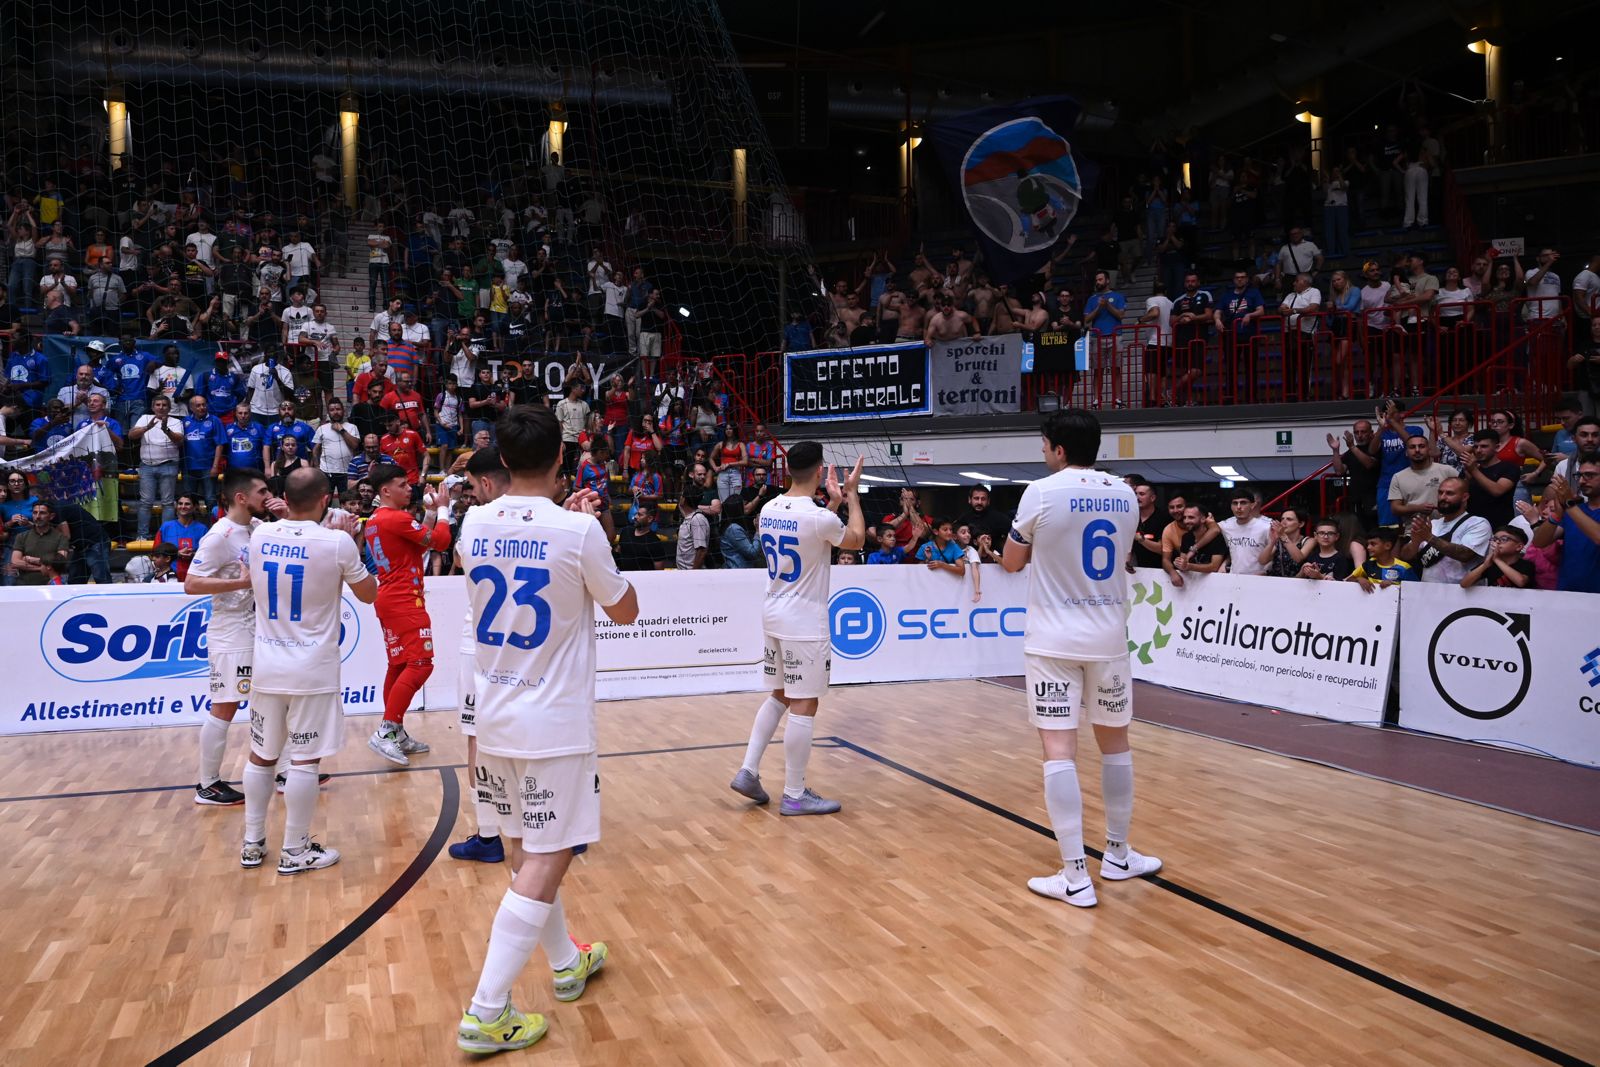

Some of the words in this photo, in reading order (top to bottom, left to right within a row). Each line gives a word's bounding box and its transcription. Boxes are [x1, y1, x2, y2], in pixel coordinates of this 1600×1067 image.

[1041, 335, 1068, 346] ULTRAS
[946, 343, 1005, 360] sporchi
[817, 354, 899, 381] EFFETTO
[954, 360, 998, 373] brutti
[971, 371, 983, 385] &
[794, 384, 921, 411] COLLATERALE
[937, 385, 1017, 406] terroni
[1070, 498, 1130, 513] PERUGINO
[760, 517, 798, 533] SAPONARA
[261, 542, 310, 560] CANAL
[472, 538, 489, 557] DE
[494, 539, 549, 561] SIMONE
[761, 533, 802, 583] 65
[1082, 518, 1117, 581] 6
[262, 561, 305, 622] 11
[469, 564, 552, 650] 23
[638, 616, 670, 628] quadri
[672, 614, 711, 625] elettrici
[712, 616, 728, 626] per
[57, 611, 210, 664] Sorb
[595, 630, 630, 640] estione
[641, 629, 647, 638] il
[650, 627, 697, 638] controllo.
[1181, 603, 1382, 667] siciliarottami
[1176, 647, 1194, 660] Rifiuti
[1195, 650, 1220, 666] speciali
[1220, 655, 1258, 673] pericolosi,
[1260, 664, 1275, 674] non
[1276, 666, 1315, 681] pericolosi
[1317, 672, 1323, 681] e
[1324, 673, 1378, 690] recuperabili
[1439, 652, 1518, 673] VOLVO
[21, 697, 164, 722] Allestimenti
[171, 699, 184, 714] e
[1048, 706, 1071, 715] SAFETY
